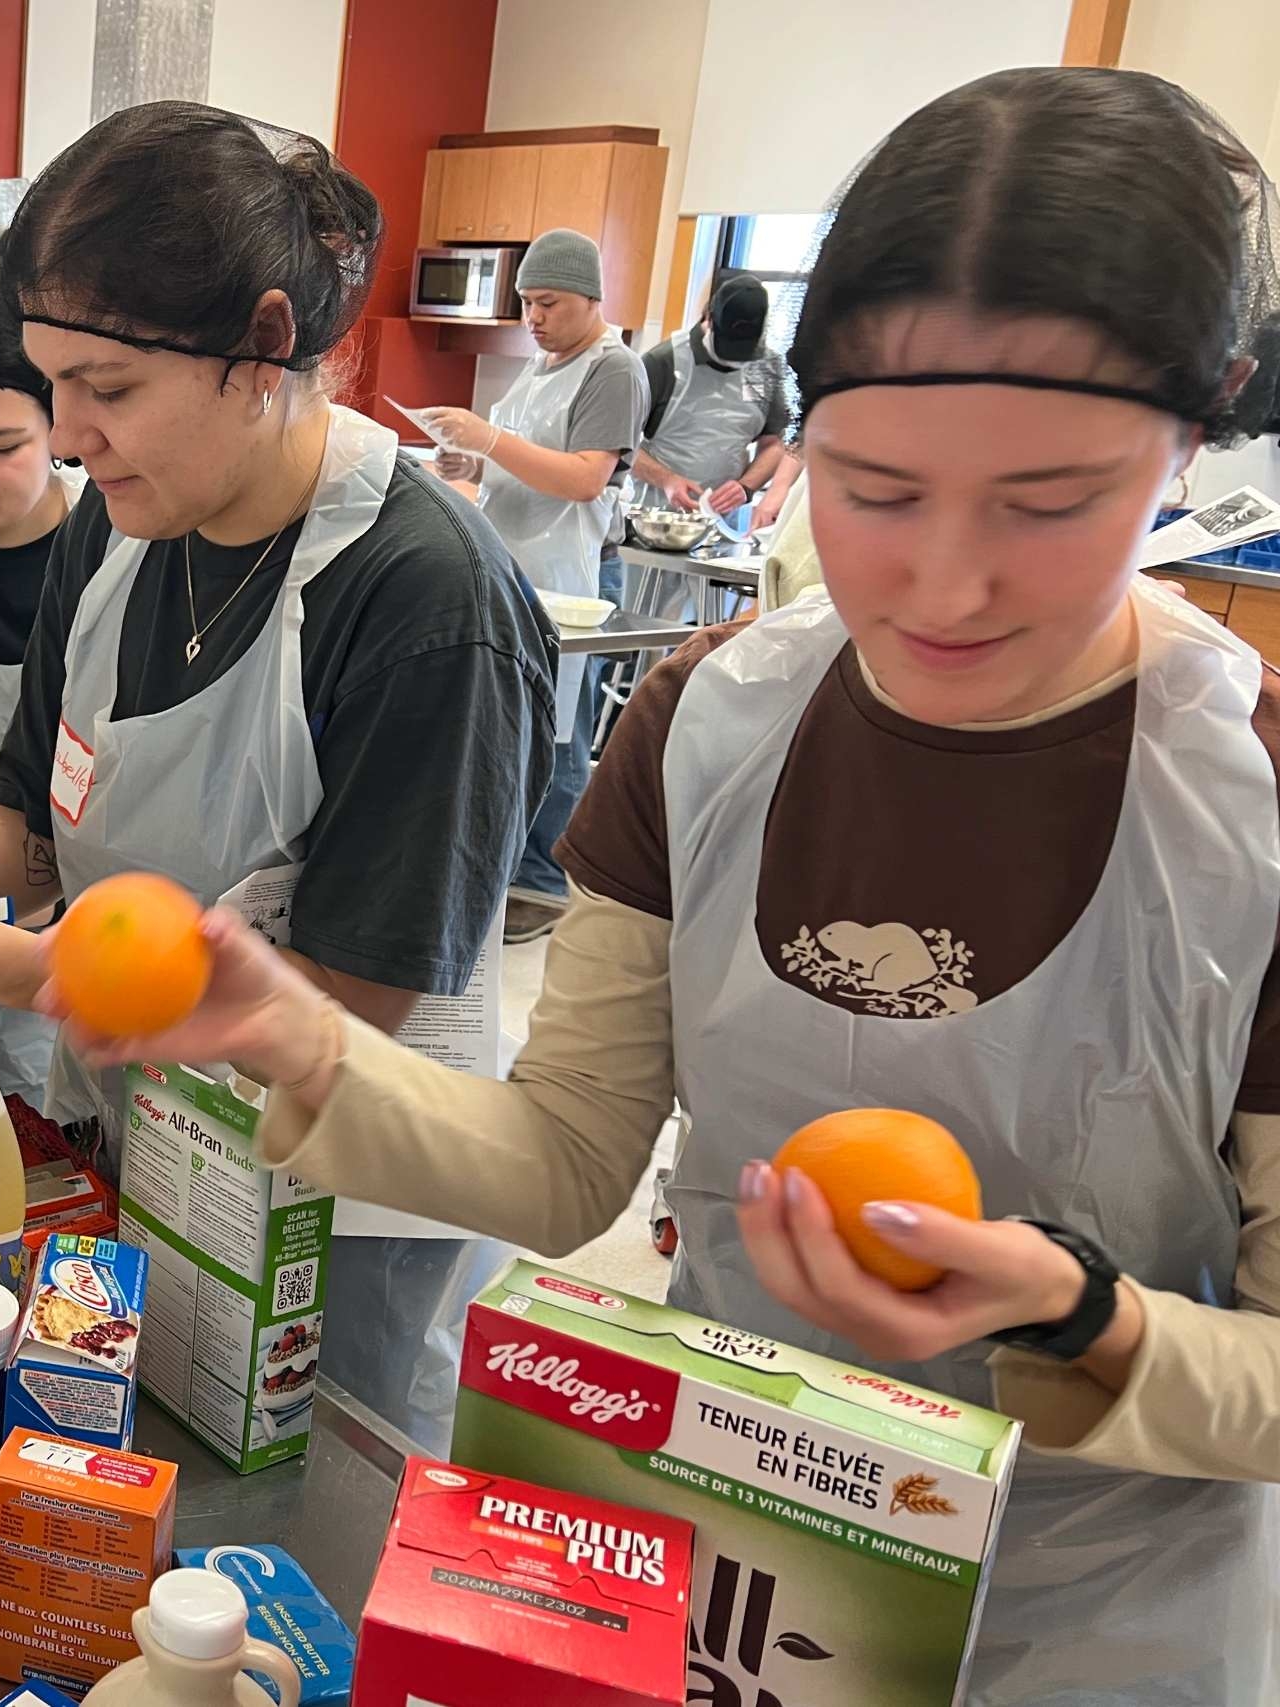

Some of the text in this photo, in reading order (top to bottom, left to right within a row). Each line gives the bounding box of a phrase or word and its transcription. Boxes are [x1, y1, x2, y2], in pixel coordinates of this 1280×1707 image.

[134, 1094, 167, 1122] Kellogg's
[169, 1111, 223, 1156] All-Bran
[225, 1146, 256, 1173] Buds
[282, 1218, 320, 1236] DELICIOUS
[286, 1211, 307, 1223] SCAN
[69, 1262, 108, 1307] Crisco
[701, 1327, 779, 1361] Bran
[486, 1342, 649, 1424] Kellogg's
[841, 1373, 962, 1420] Kellogg's
[698, 1401, 885, 1486] TENEUR ÉLEVÉE
[757, 1451, 879, 1511] EN FIBRES
[21, 1492, 33, 1501] For
[40, 1496, 68, 1510] Fresher
[97, 1509, 120, 1521] Home
[480, 1496, 667, 1561] PREMIUM
[648, 1455, 962, 1578] SOURCE DE 13 VITAMINES ET MINÉRAUX
[7, 1541, 22, 1550] une
[23, 1545, 48, 1558] maison
[50, 1550, 65, 1562] plus
[66, 1556, 91, 1569] propre
[92, 1559, 102, 1569] et
[102, 1562, 117, 1574] plus
[231, 1556, 262, 1594] compliments
[566, 1539, 666, 1588] PLUS
[33, 1624, 58, 1639] UNE
[40, 1610, 107, 1635] COUNTLESS
[109, 1628, 136, 1641] USES.
[257, 1605, 283, 1641] BEURRE
[280, 1636, 296, 1659] NON
[273, 1602, 330, 1677] UNSALTED BUTTER
[23, 1668, 90, 1692] armandhammer.c
[77, 1651, 121, 1668] UTILISATI
